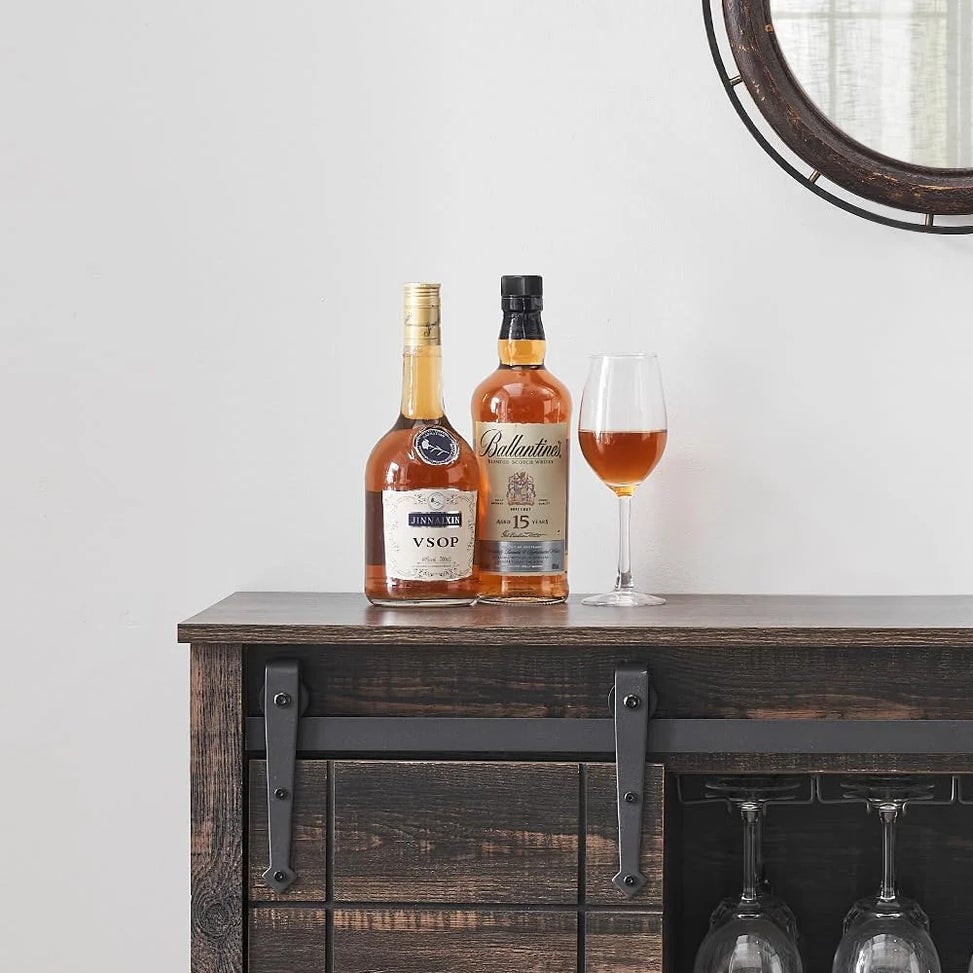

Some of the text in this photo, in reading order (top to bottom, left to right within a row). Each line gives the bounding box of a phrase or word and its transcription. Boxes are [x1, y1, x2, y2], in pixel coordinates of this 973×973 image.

[480, 429, 562, 458] Ballantine's
[513, 515, 530, 529] 15
[412, 536, 459, 548] VSOP
